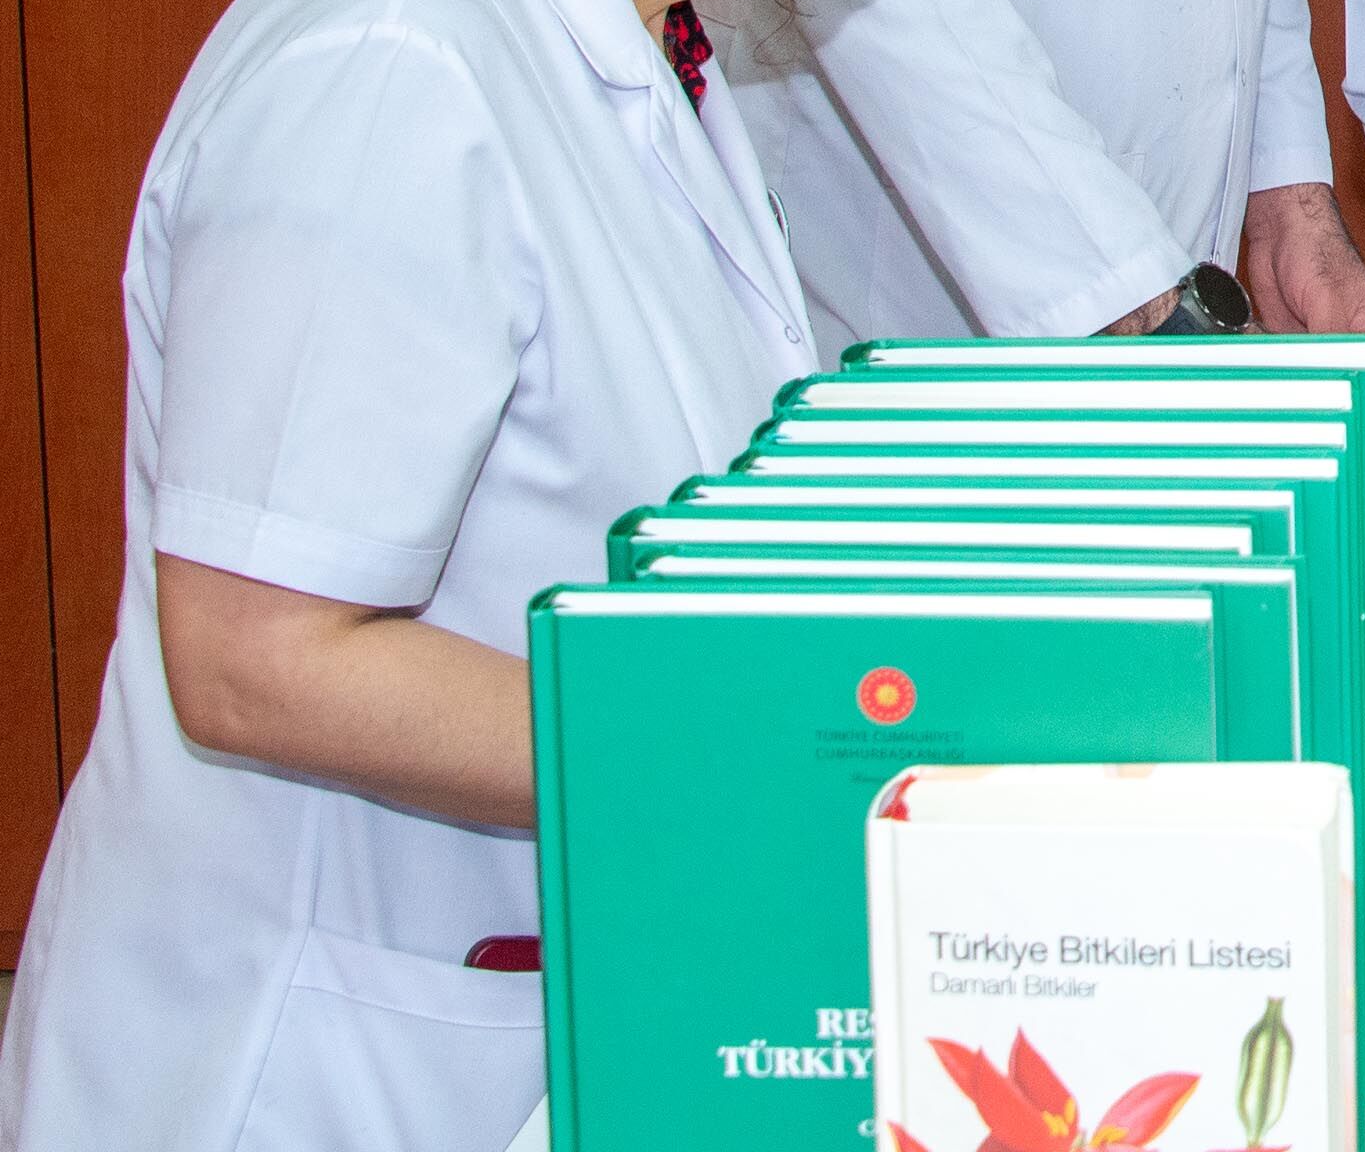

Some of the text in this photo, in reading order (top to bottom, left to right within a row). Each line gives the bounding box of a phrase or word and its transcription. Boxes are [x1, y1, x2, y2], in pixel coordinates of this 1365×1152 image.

[929, 930, 1292, 970] Türkiye Bitkileri Listesi
[1023, 973, 1099, 999] Bitkiler
[717, 1038, 874, 1079] TÜRKİY
